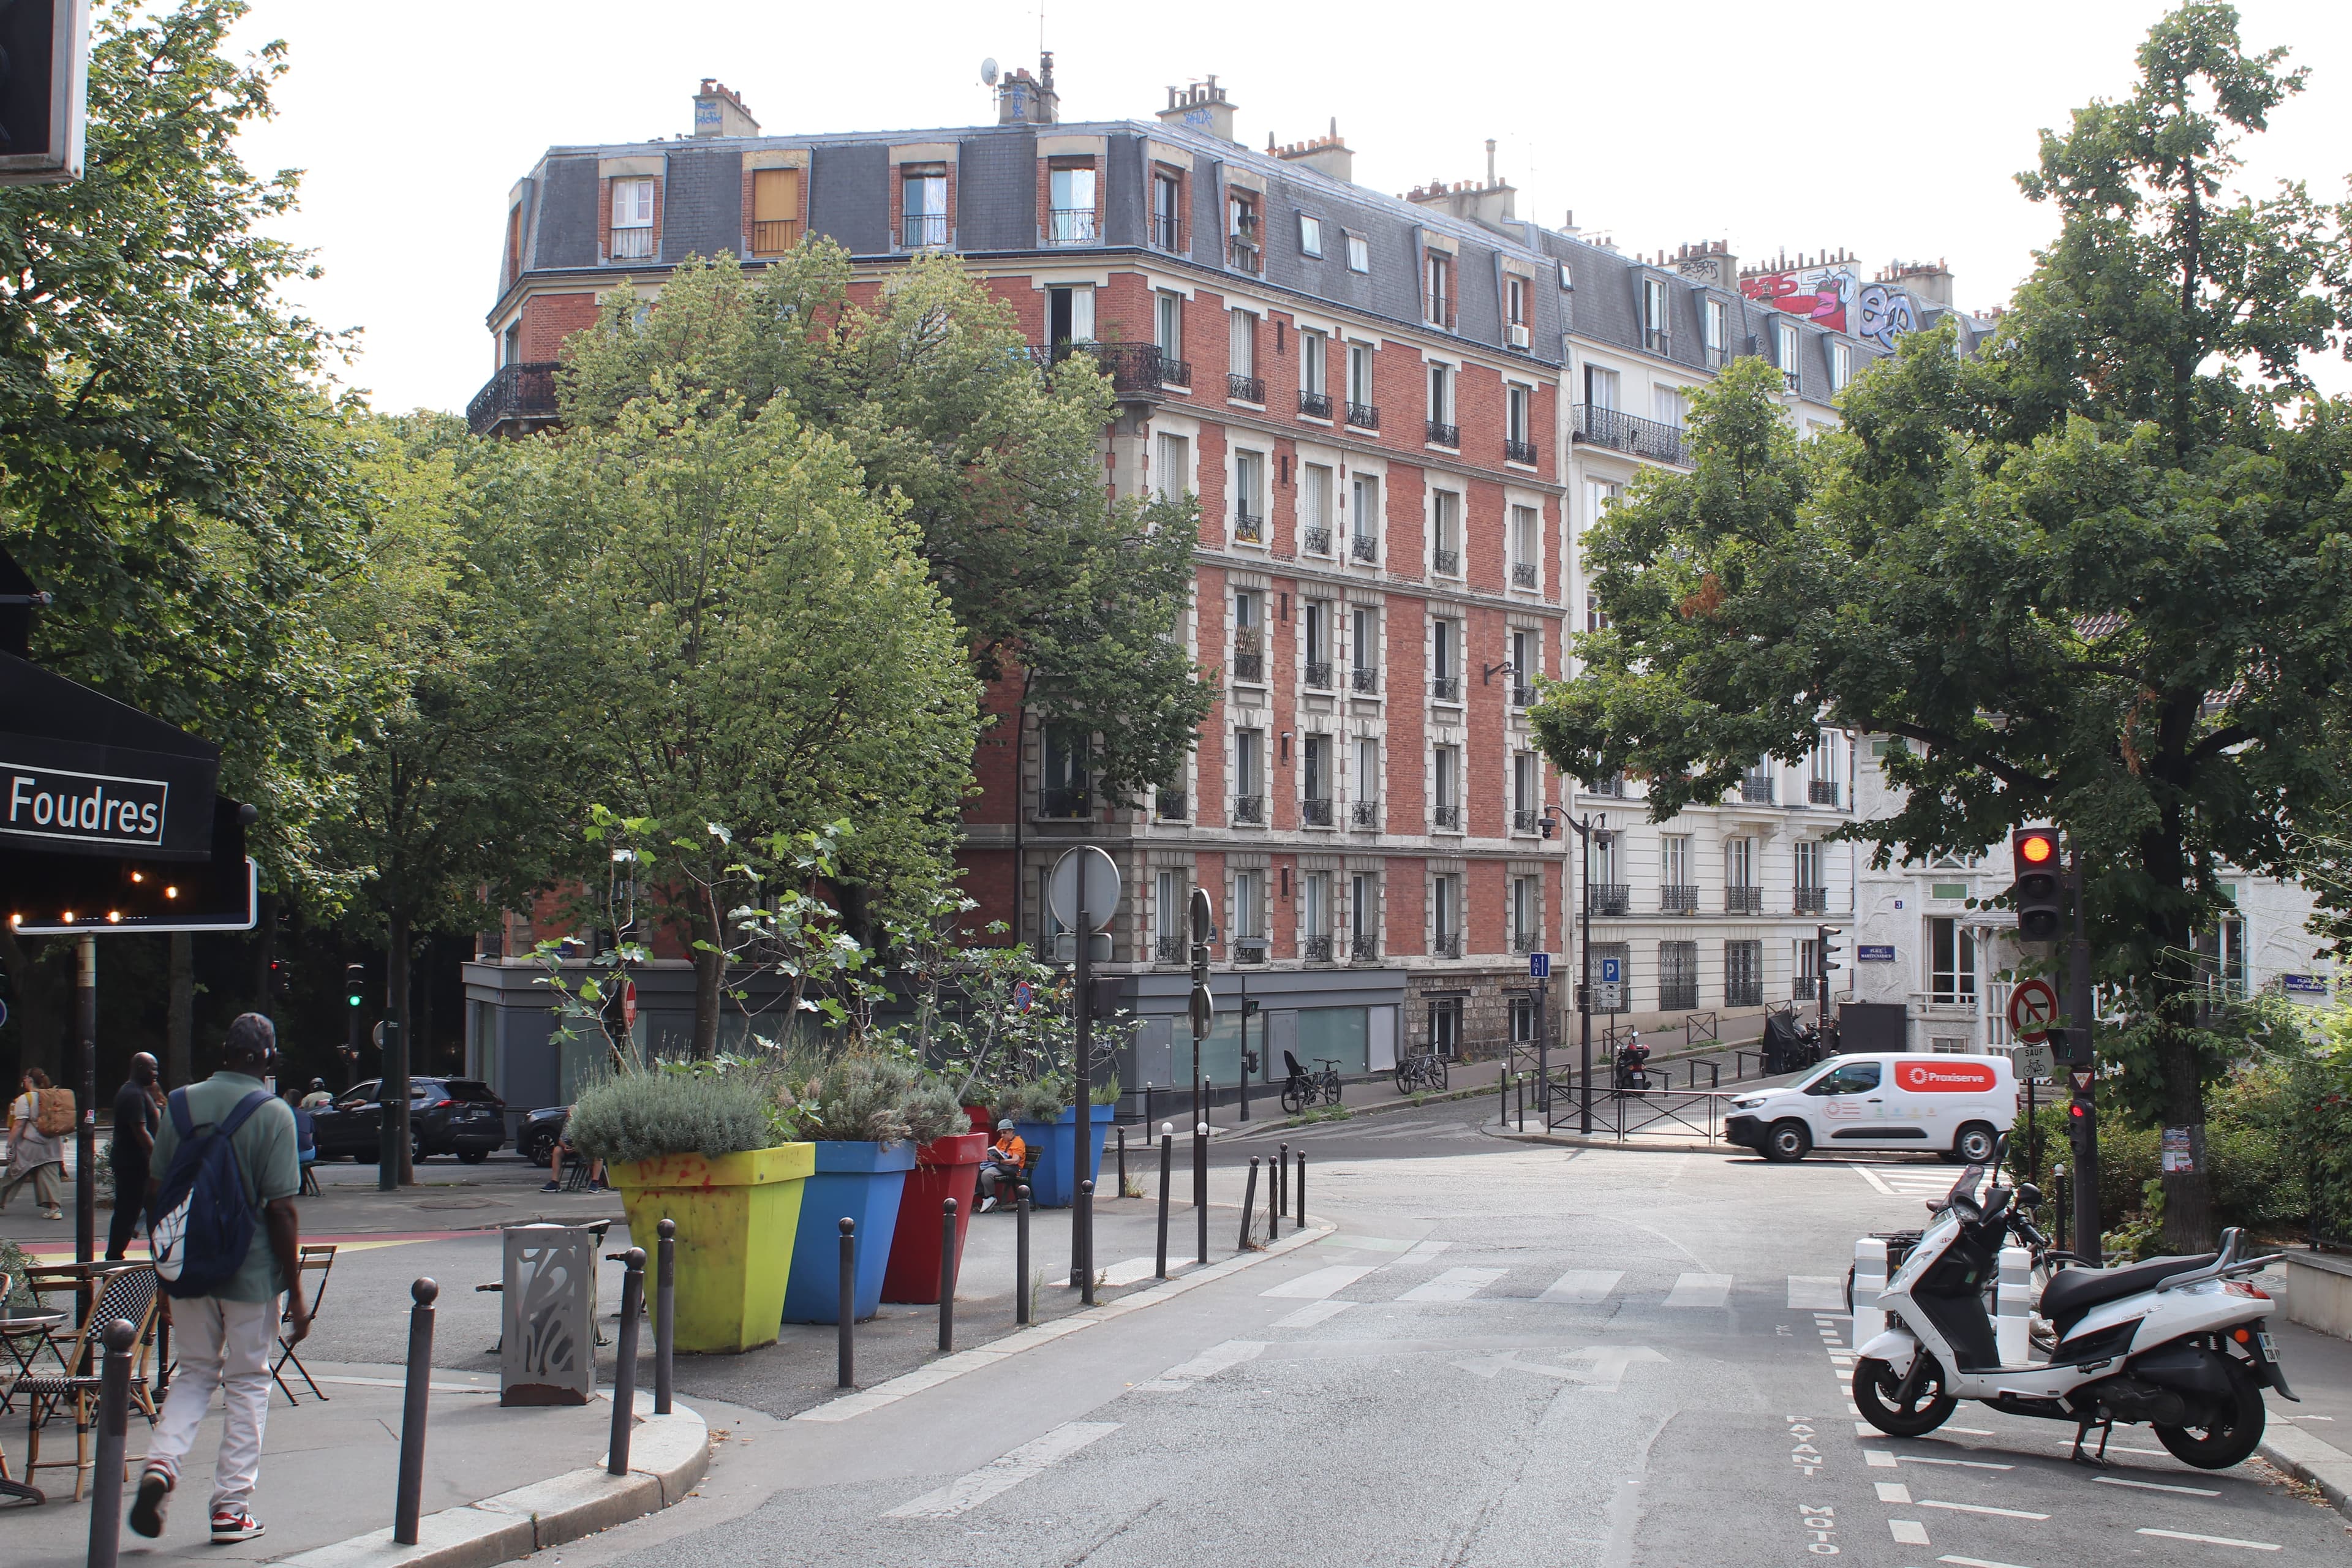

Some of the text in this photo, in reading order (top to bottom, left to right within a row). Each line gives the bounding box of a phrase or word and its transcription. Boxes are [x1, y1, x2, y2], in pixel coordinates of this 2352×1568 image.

[9, 775, 158, 834] Foudres
[1607, 963, 1615, 978] P
[2025, 1048, 2043, 1057] SAUF
[1928, 1072, 1985, 1082] Proxiserve
[1786, 1415, 1840, 1555] PAYANT MOTO
